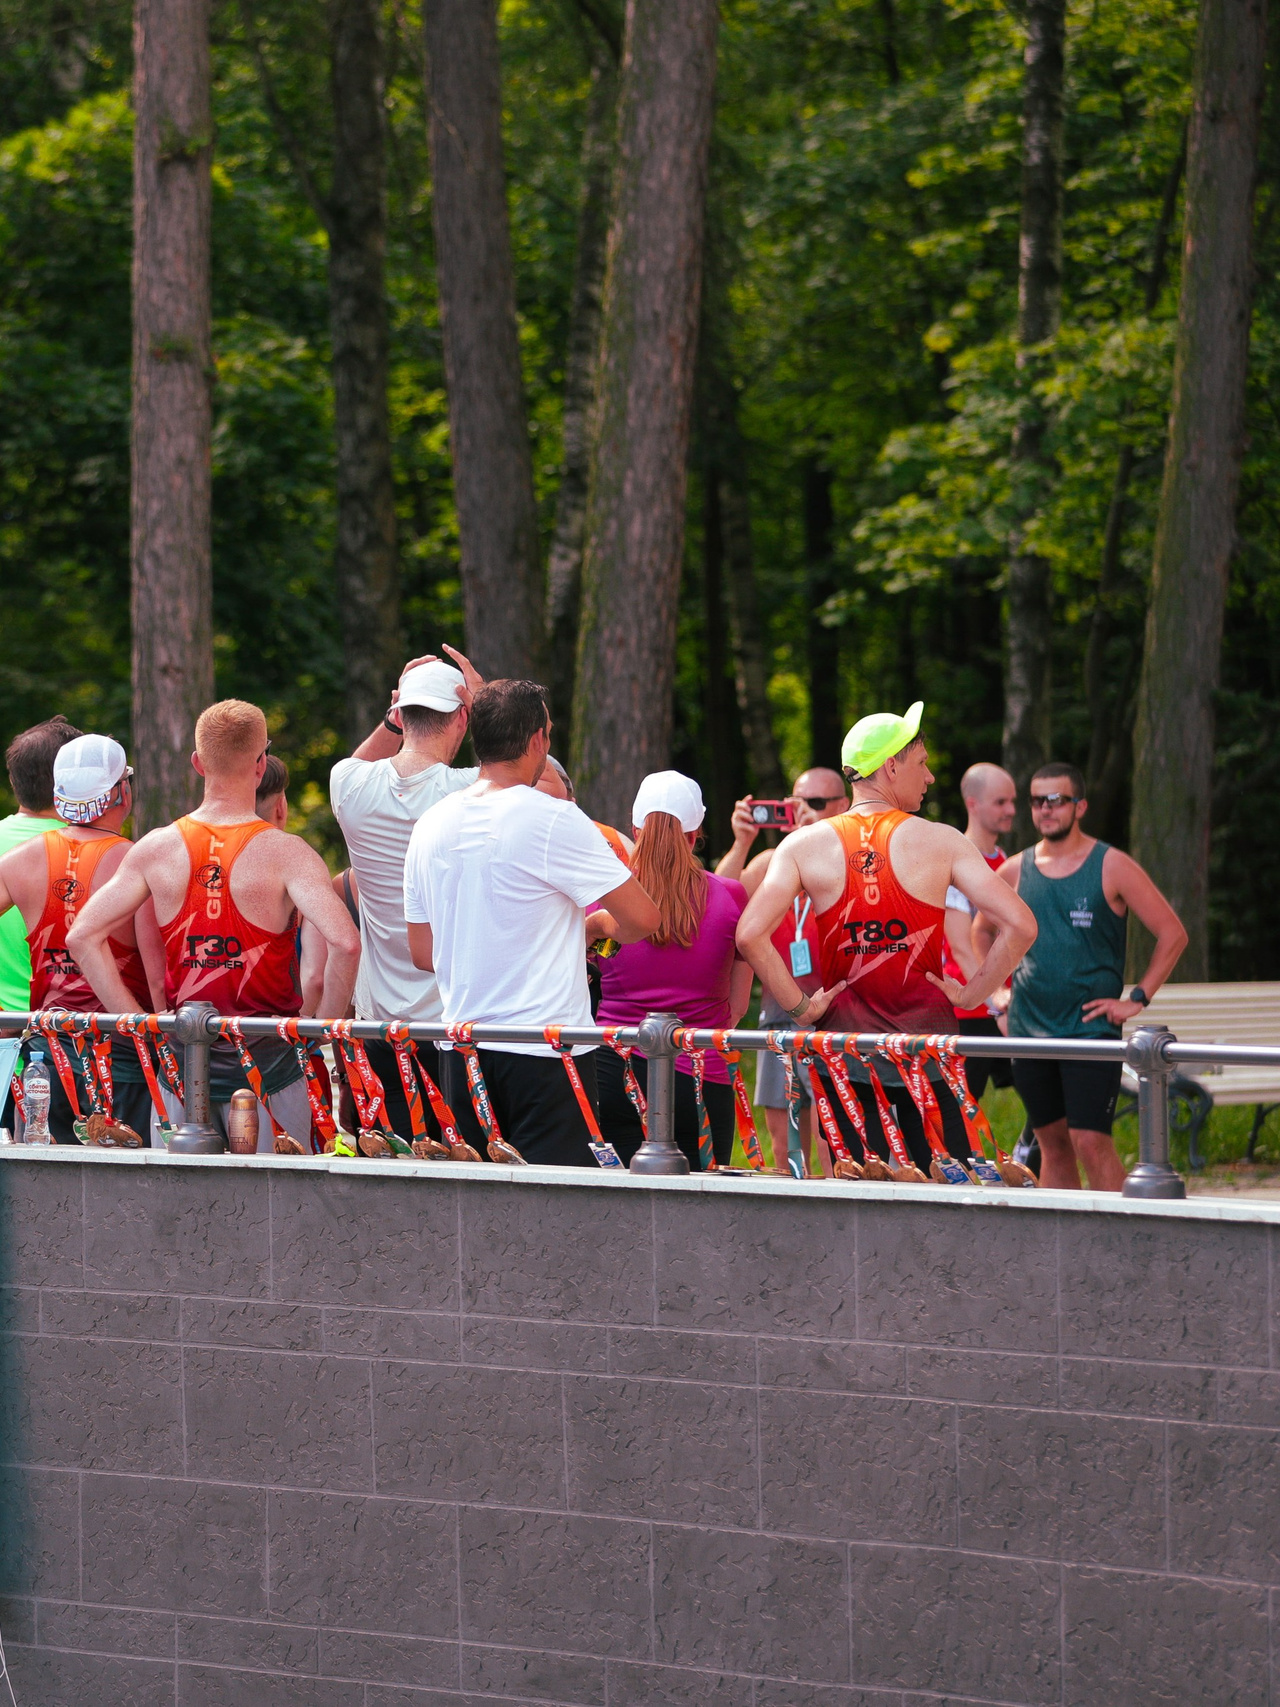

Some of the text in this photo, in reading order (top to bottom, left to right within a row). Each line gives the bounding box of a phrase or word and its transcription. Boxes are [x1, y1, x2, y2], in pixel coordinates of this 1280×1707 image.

[843, 918, 908, 943] T80
[186, 935, 242, 958] T30
[843, 943, 909, 957] FINISHER
[182, 959, 244, 970] FINISHER
[81, 1057, 93, 1082] Never
[161, 1046, 175, 1069] Never
[399, 1052, 410, 1083] Ultra
[468, 1056, 481, 1083] Ring
[11, 1076, 23, 1097] 100
[167, 1071, 181, 1087] give
[85, 1082, 98, 1102] give
[948, 1083, 964, 1101] give
[964, 1101, 975, 1114] up
[368, 1096, 381, 1121] GRUT
[846, 1101, 863, 1128] Ring
[818, 1097, 840, 1147] Trail 100
[886, 1125, 903, 1152] Ring
